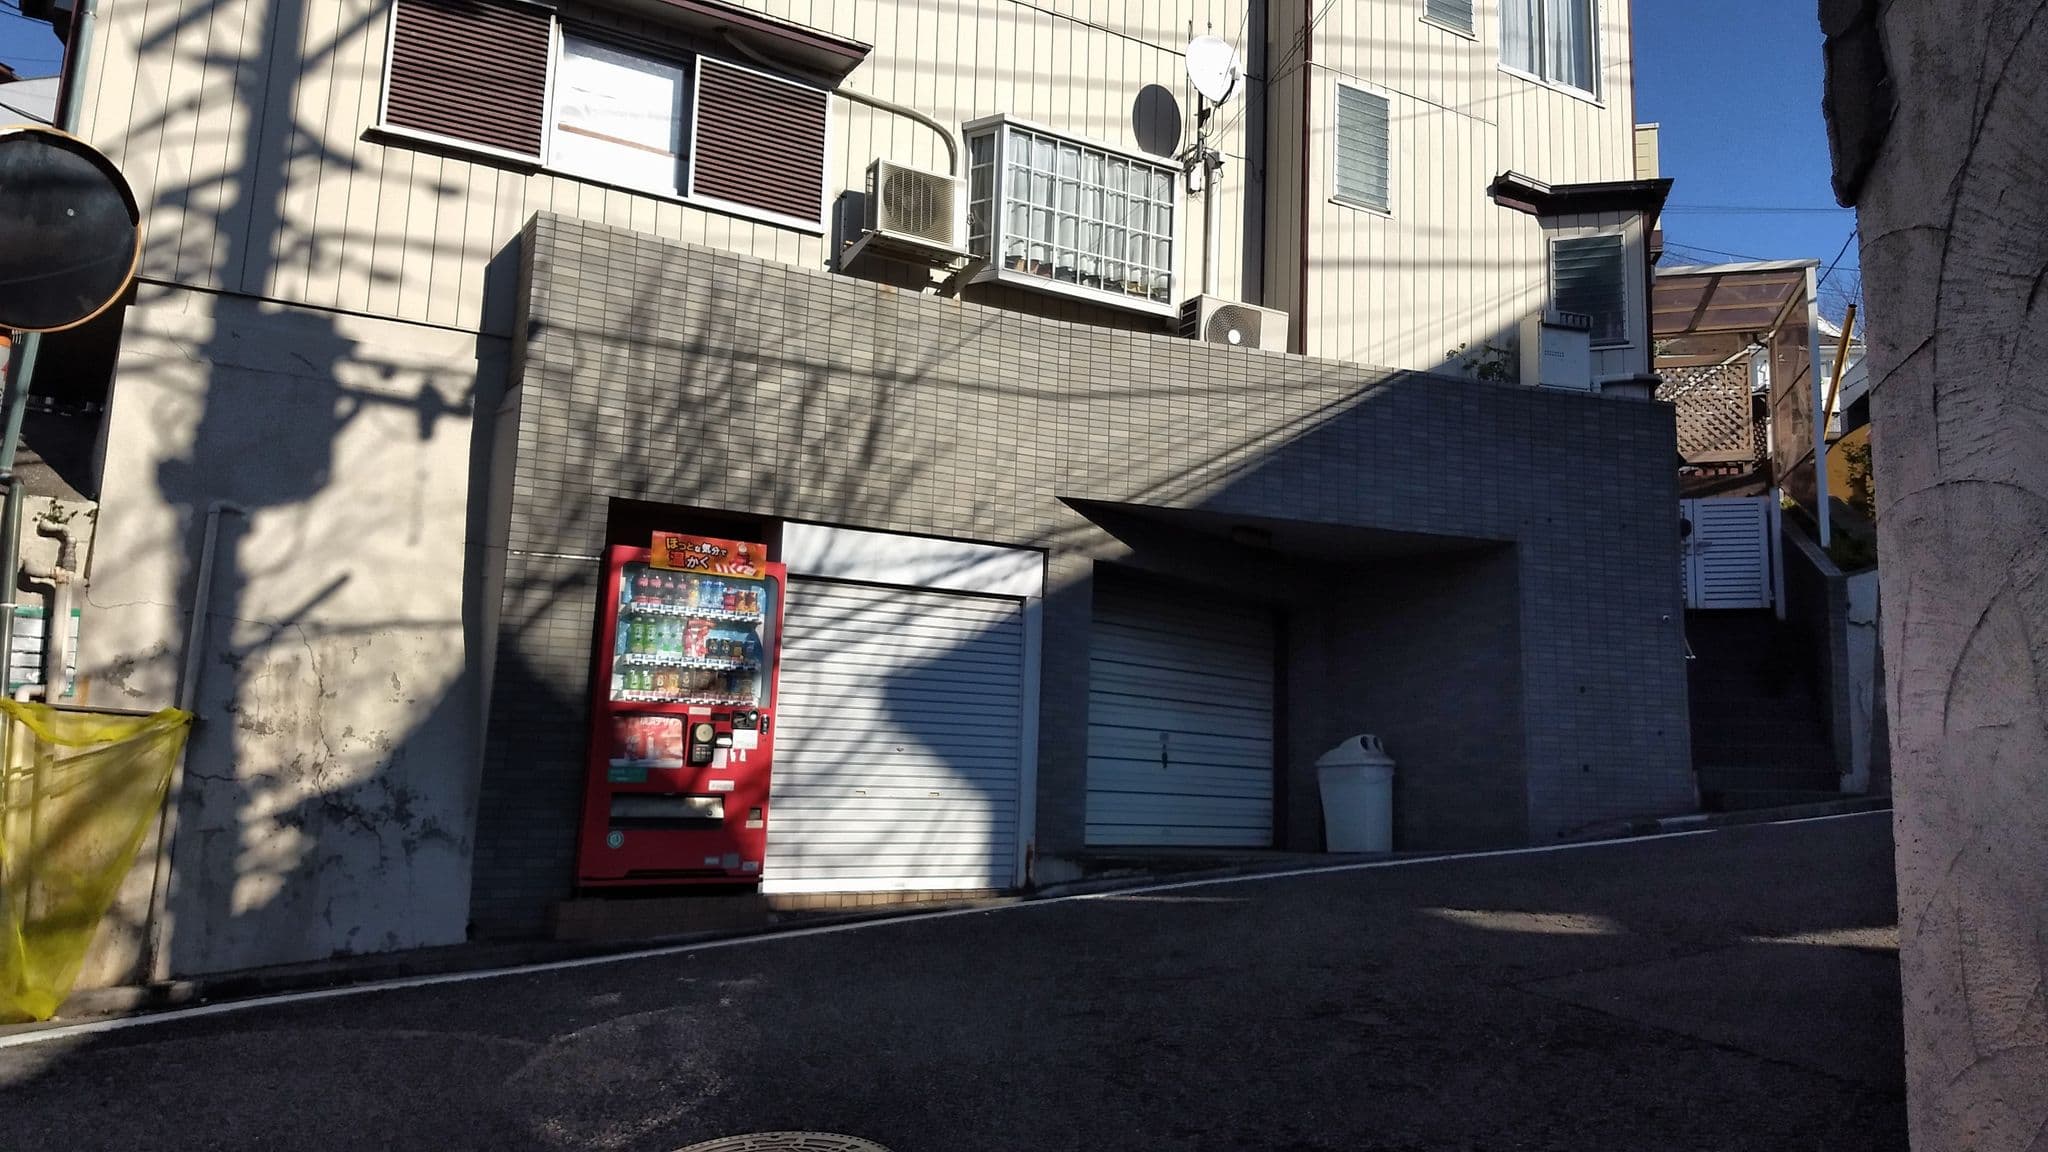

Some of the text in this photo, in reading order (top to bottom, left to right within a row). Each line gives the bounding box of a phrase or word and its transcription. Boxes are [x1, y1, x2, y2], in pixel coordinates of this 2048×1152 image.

[666, 537, 727, 556] ほっとな気分で
